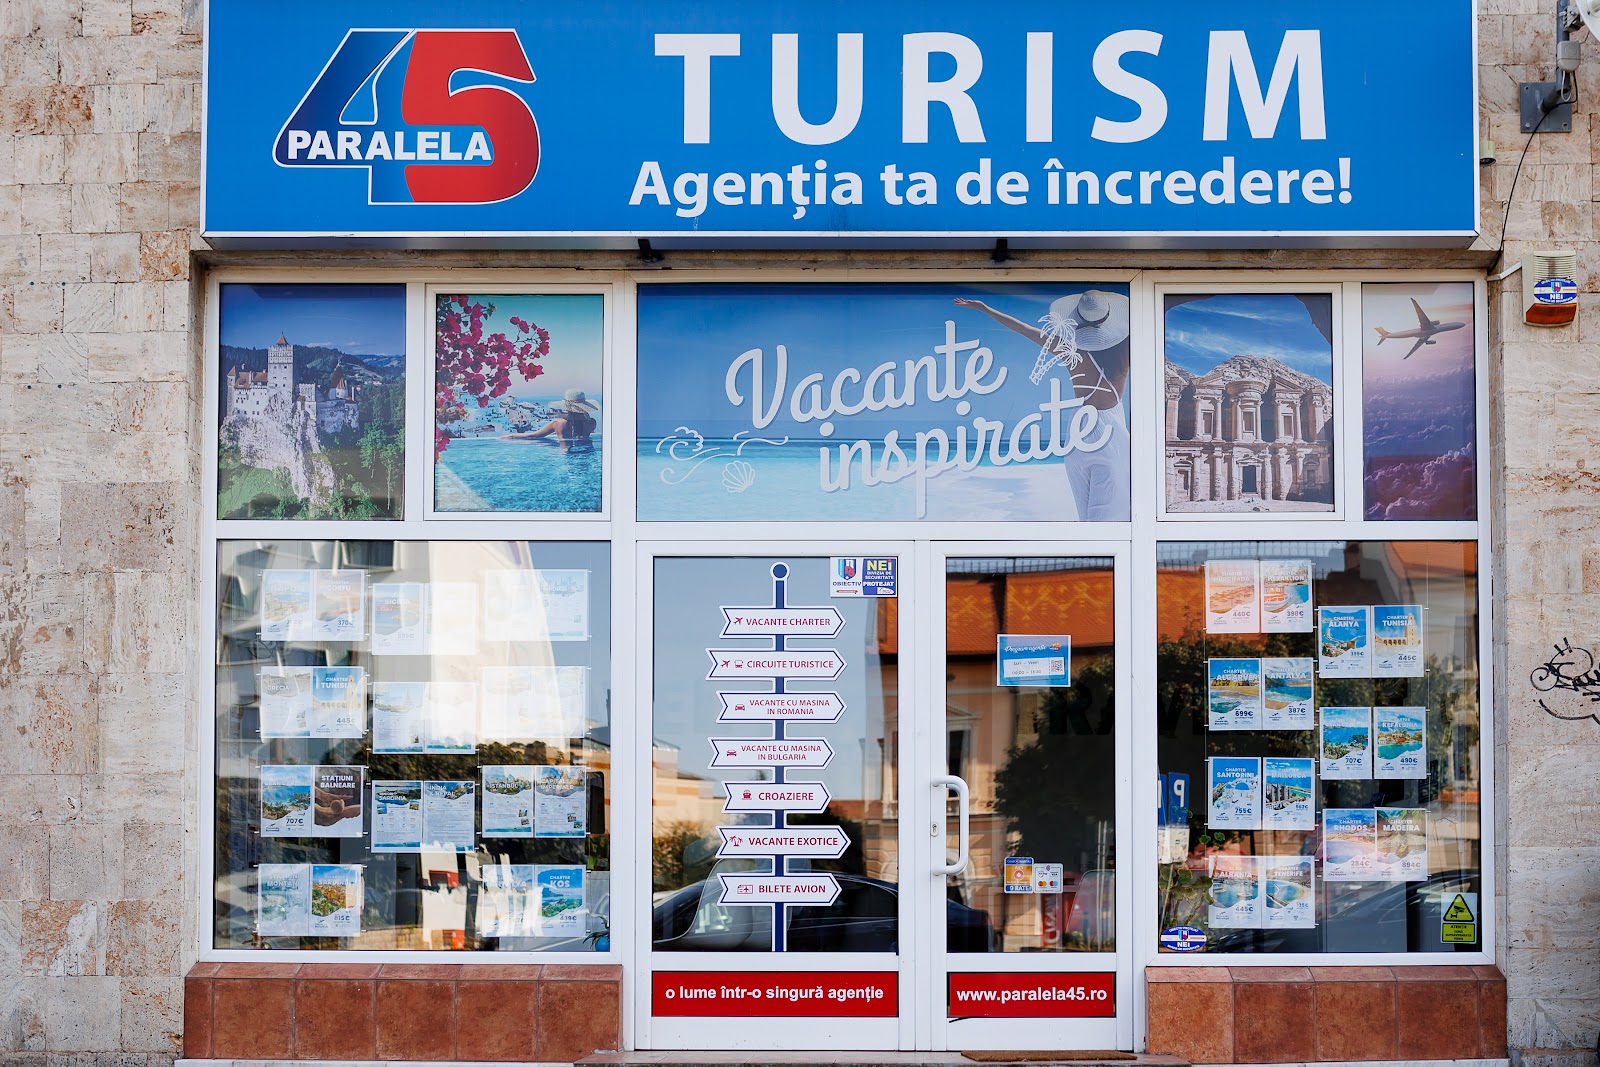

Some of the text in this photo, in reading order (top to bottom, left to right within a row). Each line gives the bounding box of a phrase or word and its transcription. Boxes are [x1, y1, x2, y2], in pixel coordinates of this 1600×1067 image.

[654, 29, 1327, 145] TURISM
[287, 130, 493, 162] PARALELA
[629, 156, 1353, 219] Agenția ta de încredere!
[725, 319, 1008, 430] Vacante
[820, 378, 1114, 519] inspirate
[1287, 610, 1305, 618] 398€
[746, 618, 831, 626] VACANTE CHARTER
[1328, 620, 1360, 628] ALANYA
[746, 660, 834, 668] CIRCUITE TURISTICE
[1217, 674, 1254, 682] ALGARVE
[749, 699, 831, 707] VACANTE CU MASINA
[1235, 710, 1254, 718] 699€
[758, 792, 814, 801] CROAZIERE
[1333, 824, 1368, 832] RHODOS
[748, 837, 839, 846] VACANTE EXOTICE
[1219, 871, 1253, 879] ALBANIA
[550, 880, 571, 888] KOS
[758, 885, 826, 893] BILETE AVION
[665, 988, 675, 999] o
[679, 984, 717, 999] lume
[720, 984, 761, 999] într-o
[766, 984, 824, 1003] singură
[956, 986, 1108, 1005] www.paralela45.ro
